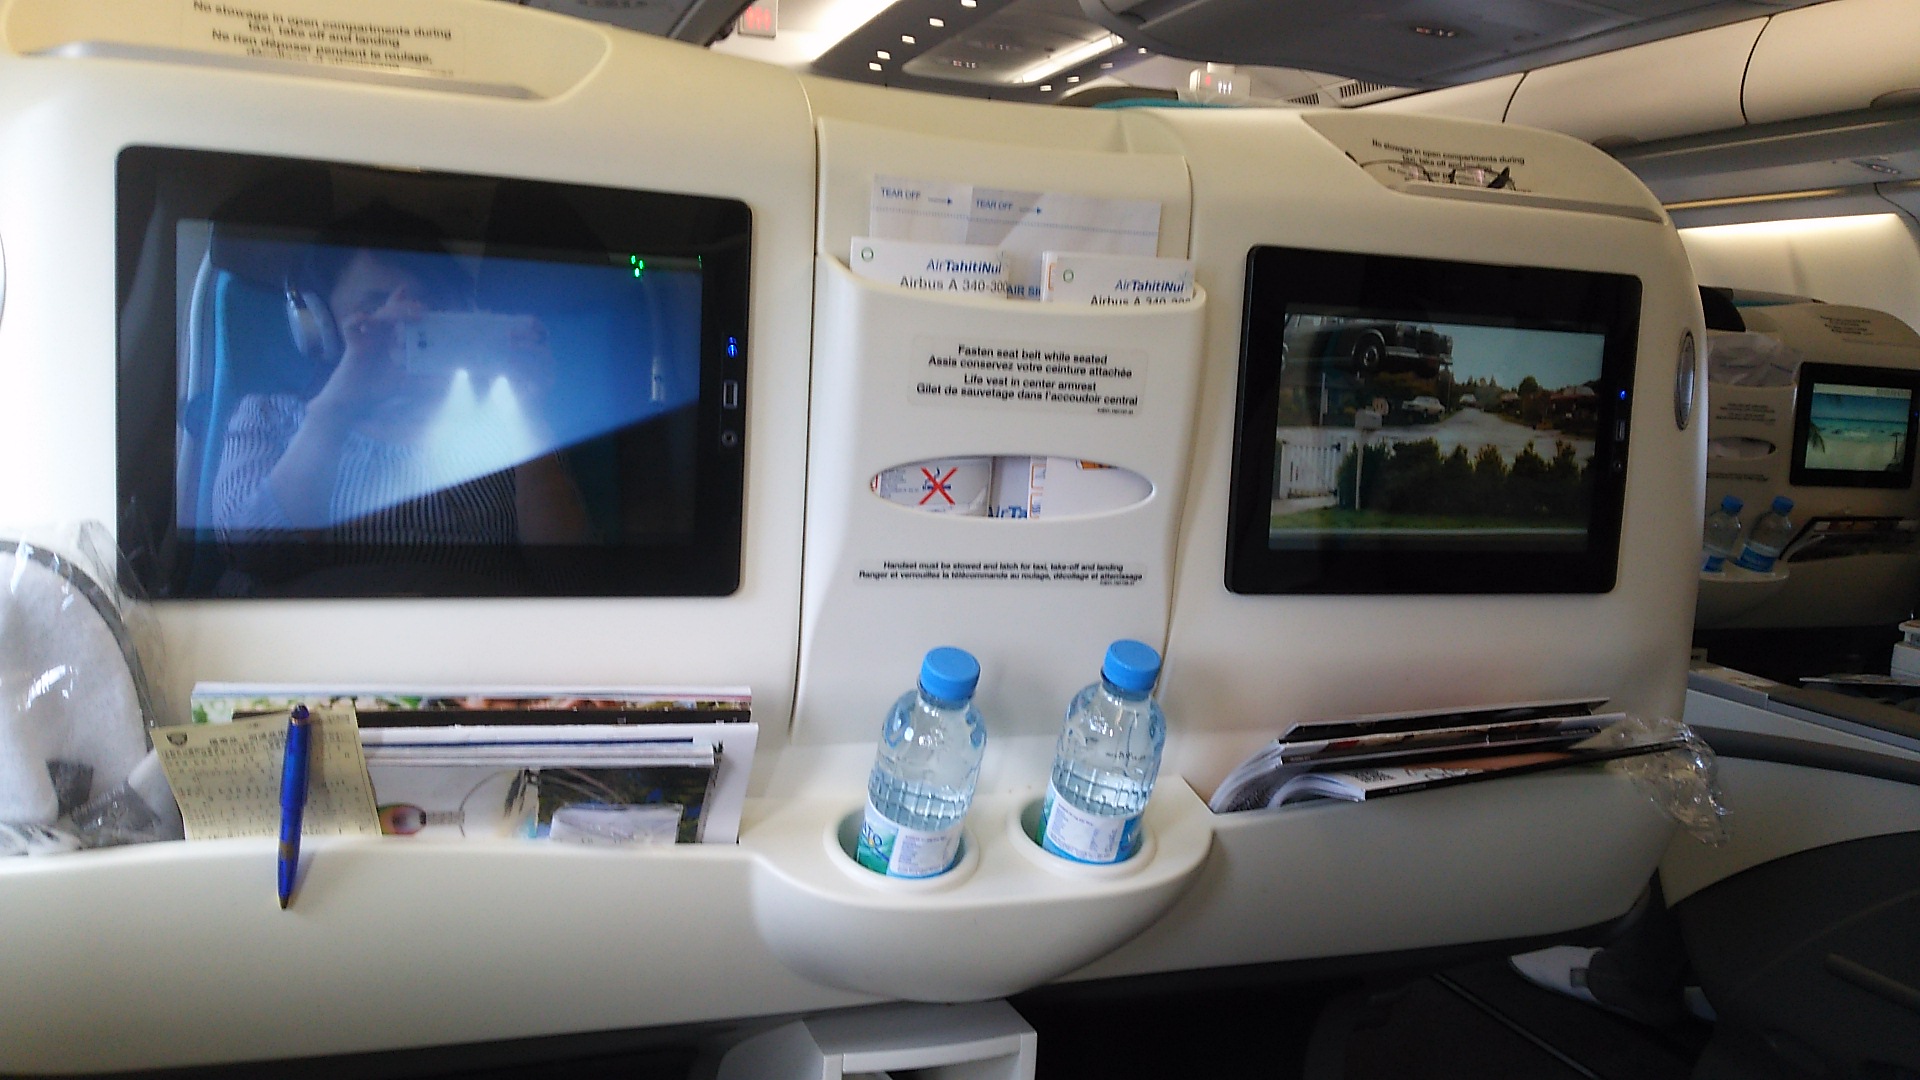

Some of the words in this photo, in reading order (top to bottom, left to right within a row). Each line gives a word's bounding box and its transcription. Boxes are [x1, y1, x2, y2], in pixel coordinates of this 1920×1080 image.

[194, 0, 211, 12] No
[272, 13, 283, 23] in
[322, 19, 410, 37] compartments
[414, 26, 451, 41] during
[329, 32, 351, 44] and
[356, 32, 400, 48] landing
[881, 187, 904, 199] TEAR
[905, 190, 921, 200] OFF
[976, 199, 997, 210] TEAR
[998, 202, 1013, 211] OFF
[900, 275, 944, 290] Airbus
[949, 279, 958, 291] A
[958, 344, 994, 358] Fasten
[997, 348, 1019, 360] seat
[1021, 348, 1041, 361] belt
[1044, 350, 1071, 363] while
[1073, 353, 1108, 366] seated
[928, 354, 957, 368] Assis
[960, 359, 1013, 371] conservez
[1017, 361, 1043, 373] votre
[1045, 364, 1087, 377] ceinture
[1089, 367, 1133, 379] attachée
[964, 373, 983, 385] Life
[986, 376, 1008, 387] vest
[1011, 376, 1020, 387] in
[1022, 378, 1055, 390] center
[1058, 381, 1097, 392] armrest
[917, 382, 941, 395] Gilet
[944, 384, 958, 396] de
[961, 387, 1015, 401] sauvetage
[1017, 389, 1043, 402] dans
[1045, 390, 1101, 405] l'accoudoir
[1103, 395, 1138, 407] central
[884, 561, 917, 569] Handset
[941, 561, 951, 570] be
[984, 561, 998, 570] and
[1081, 563, 1096, 572] and
[1097, 563, 1124, 573] landing
[859, 570, 888, 581] Ranger
